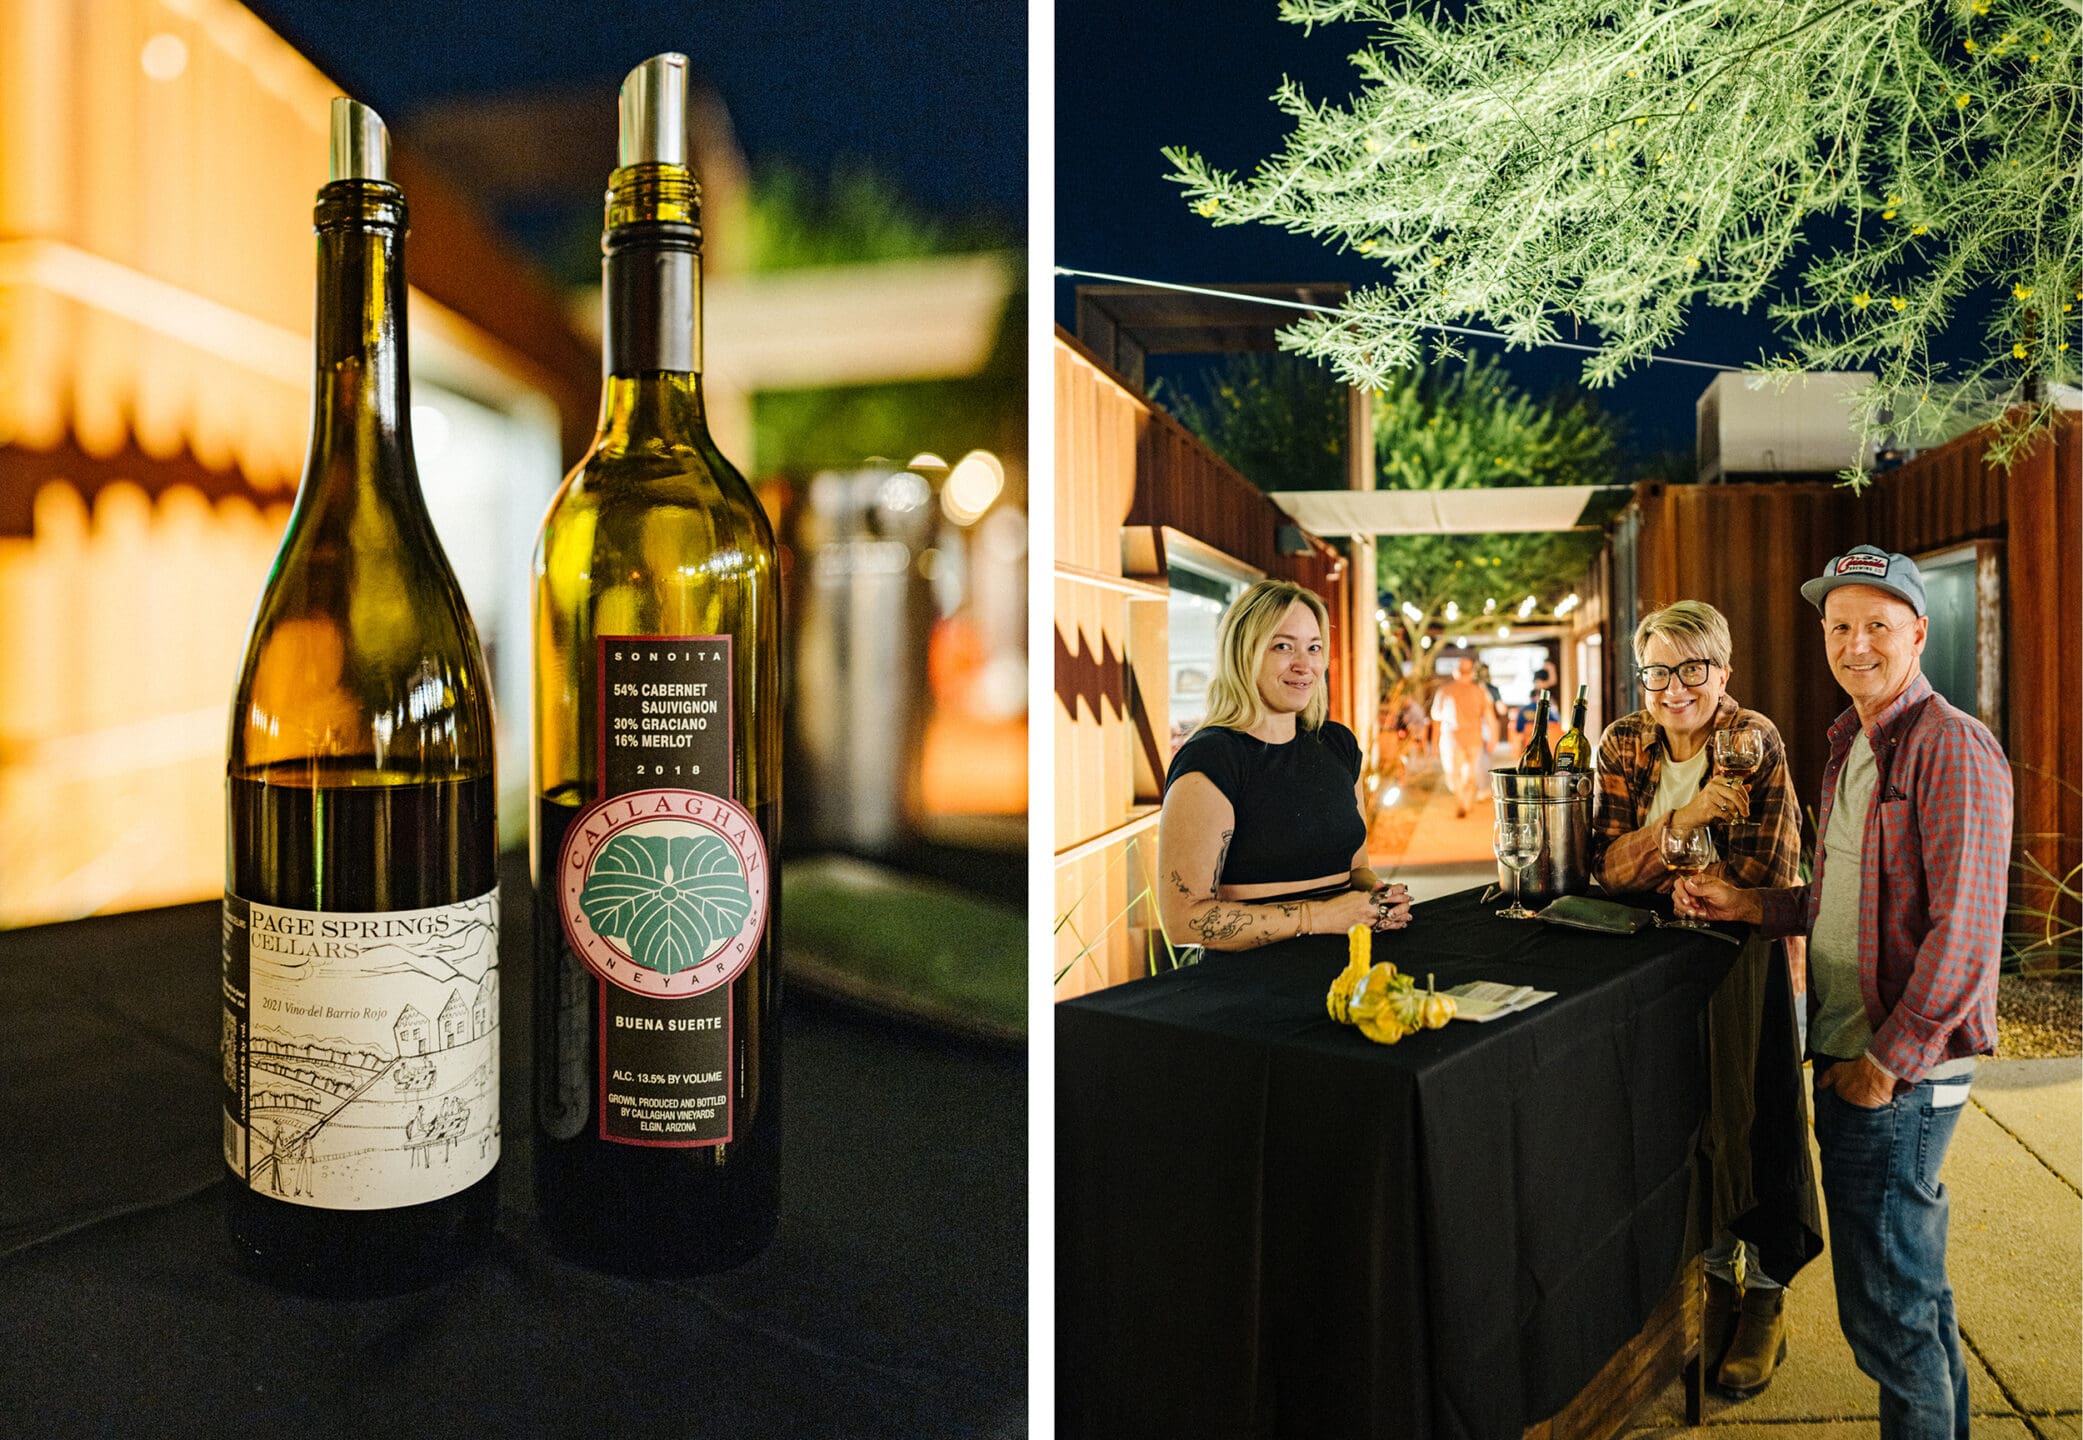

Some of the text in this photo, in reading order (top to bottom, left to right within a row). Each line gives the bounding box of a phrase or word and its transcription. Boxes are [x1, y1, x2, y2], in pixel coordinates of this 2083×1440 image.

[614, 652, 721, 662] SONOITA
[614, 683, 708, 697] 54% CABERNET
[614, 718, 707, 731] 30% GRACIANO
[614, 734, 693, 748] 16% MERLOT
[636, 765, 700, 775] 2018
[571, 795, 761, 873] CALLAGHAN
[251, 910, 314, 936] PAGE
[321, 914, 450, 939] SPRINGS
[251, 931, 360, 959] CELLARS
[574, 915, 758, 988] VINEYARDS
[262, 997, 281, 1012] 2021
[326, 1007, 360, 1019] Barrio
[363, 1009, 388, 1022] Rojo
[615, 1015, 722, 1031] BUENA SUERTE
[612, 1070, 722, 1084] ALC. 13.5% BY VOLUME
[608, 1093, 726, 1109] GROWN, PRODUCED AND BOTTLED
[620, 1108, 715, 1120] BY CALLAGHAN VINEYARDS
[640, 1122, 696, 1132] ELGIN, ARIZONA
